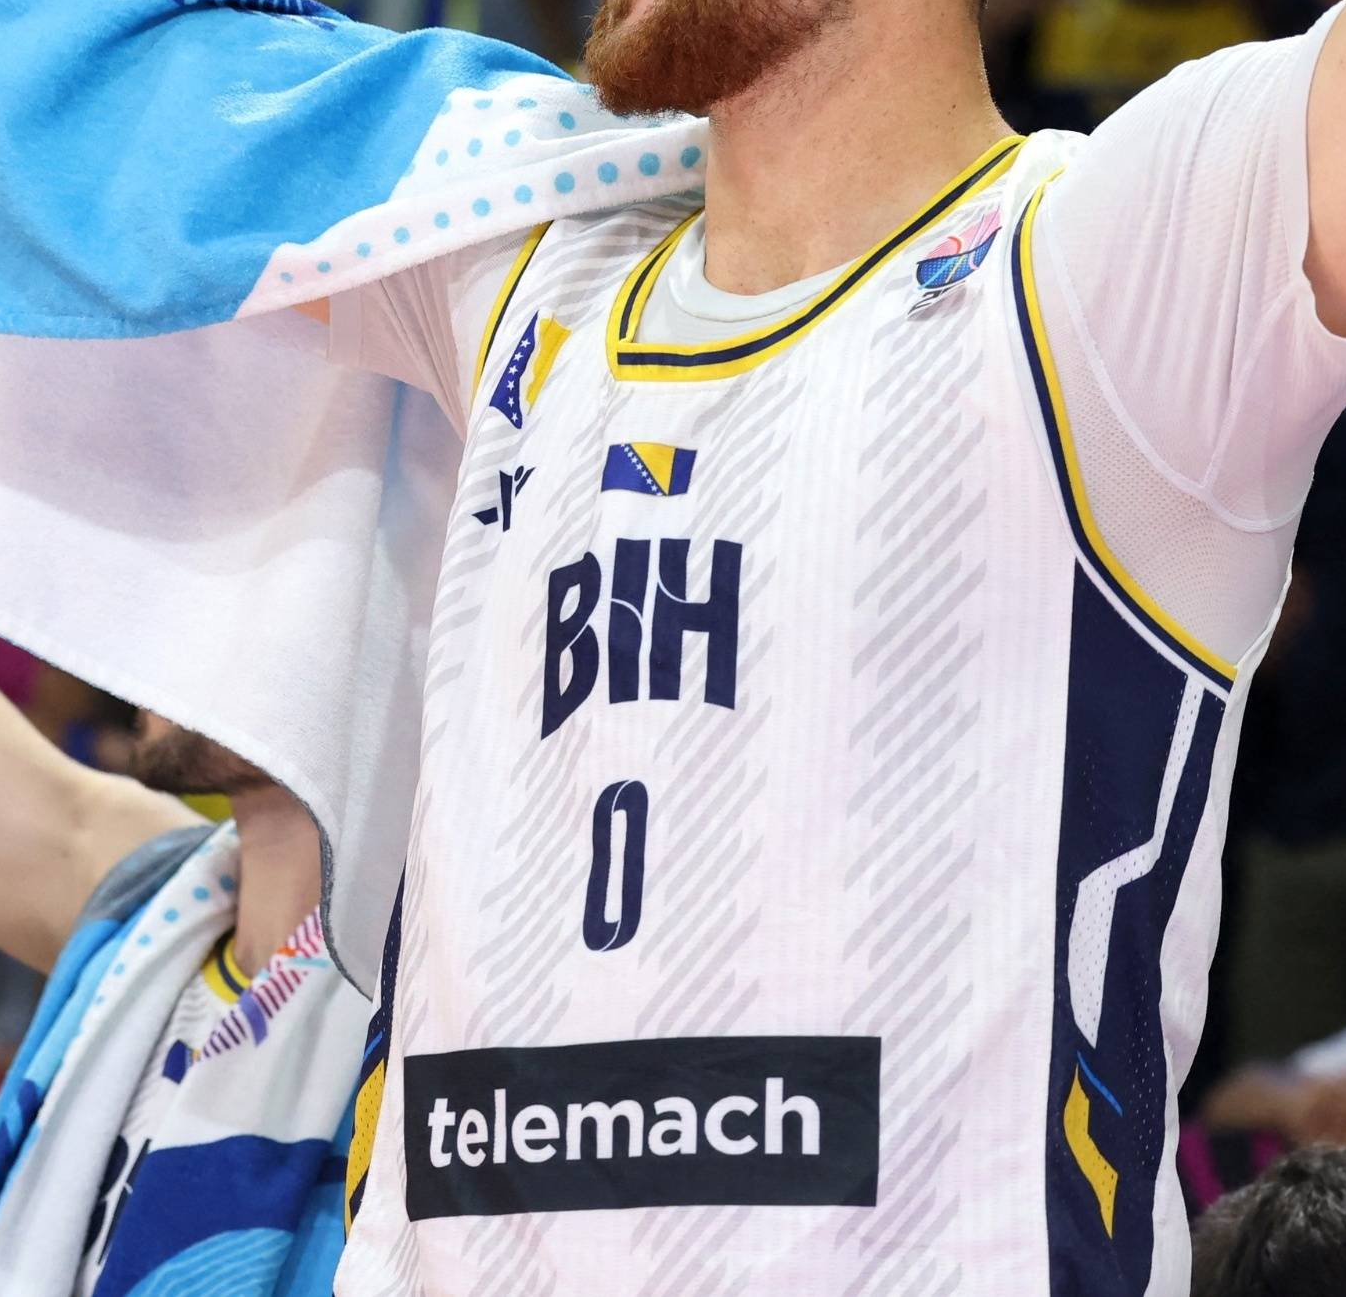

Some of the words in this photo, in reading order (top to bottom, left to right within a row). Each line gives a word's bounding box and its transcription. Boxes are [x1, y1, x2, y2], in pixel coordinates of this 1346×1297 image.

[541, 538, 743, 740] BIH
[583, 780, 649, 952] 0
[427, 1077, 820, 1169] telemach
